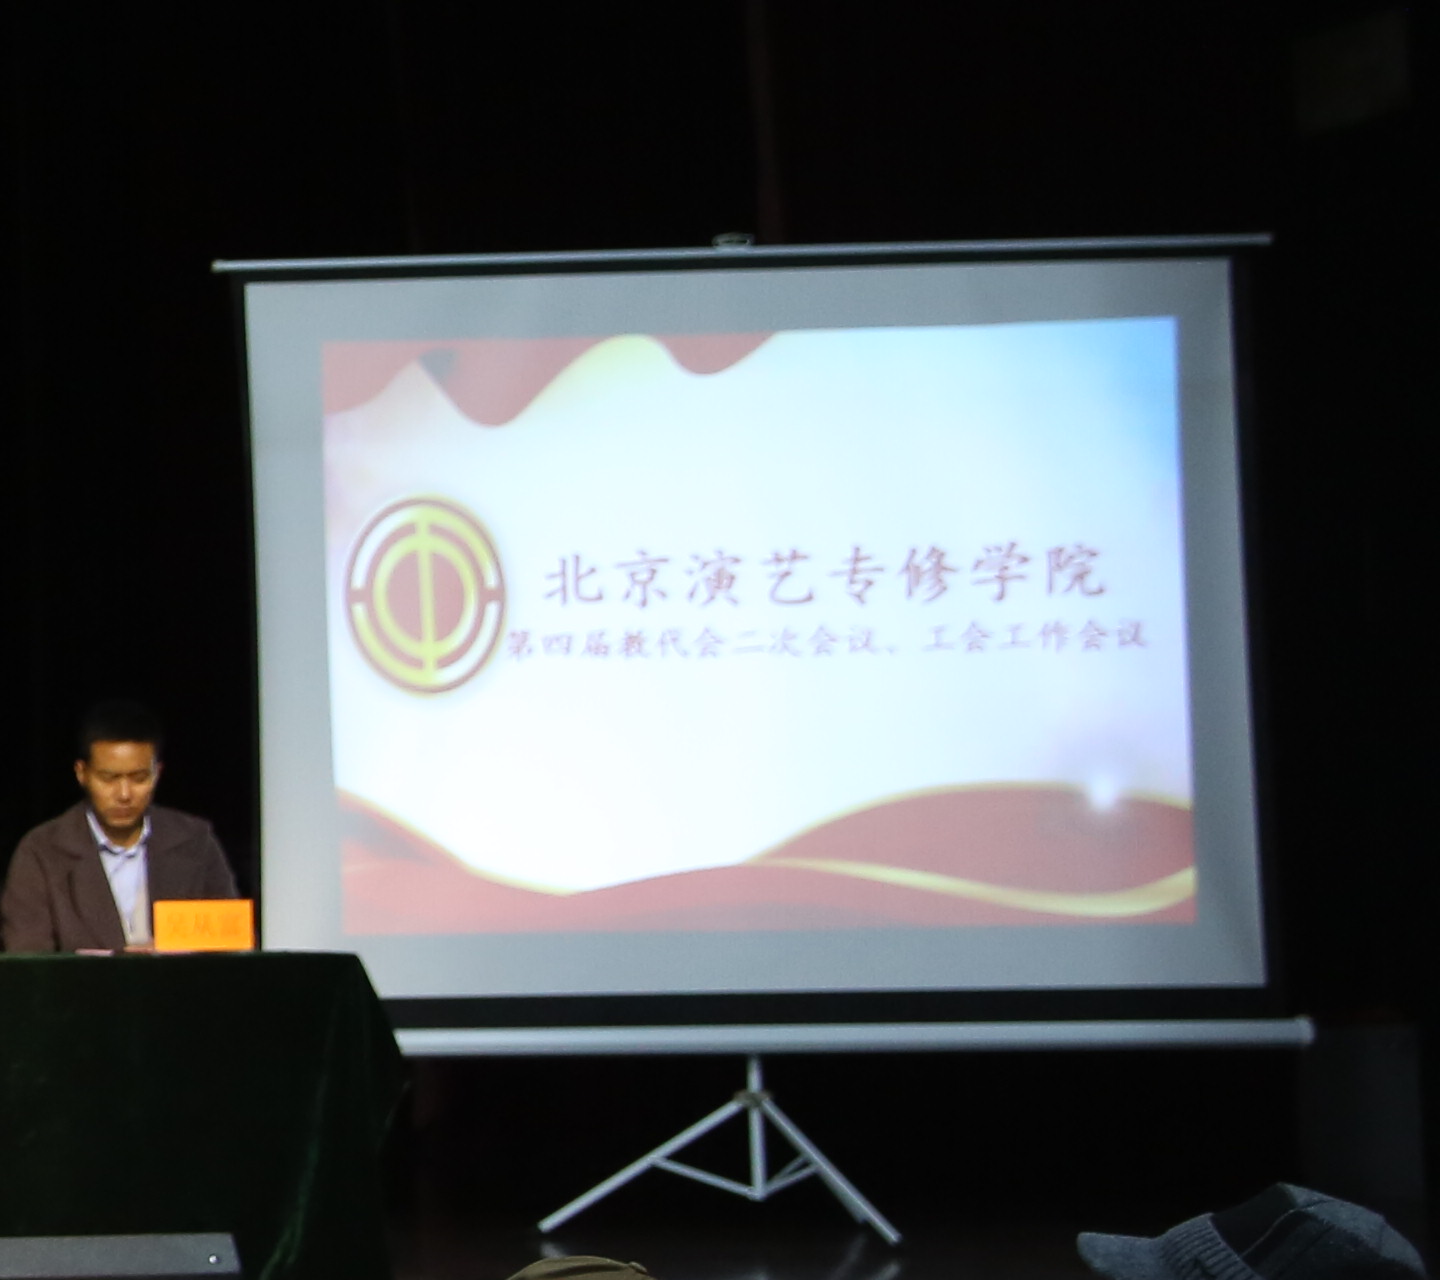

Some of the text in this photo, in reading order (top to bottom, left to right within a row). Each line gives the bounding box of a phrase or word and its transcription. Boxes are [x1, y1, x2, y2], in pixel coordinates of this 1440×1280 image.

[542, 541, 1106, 609] 北京演艺专修学院
